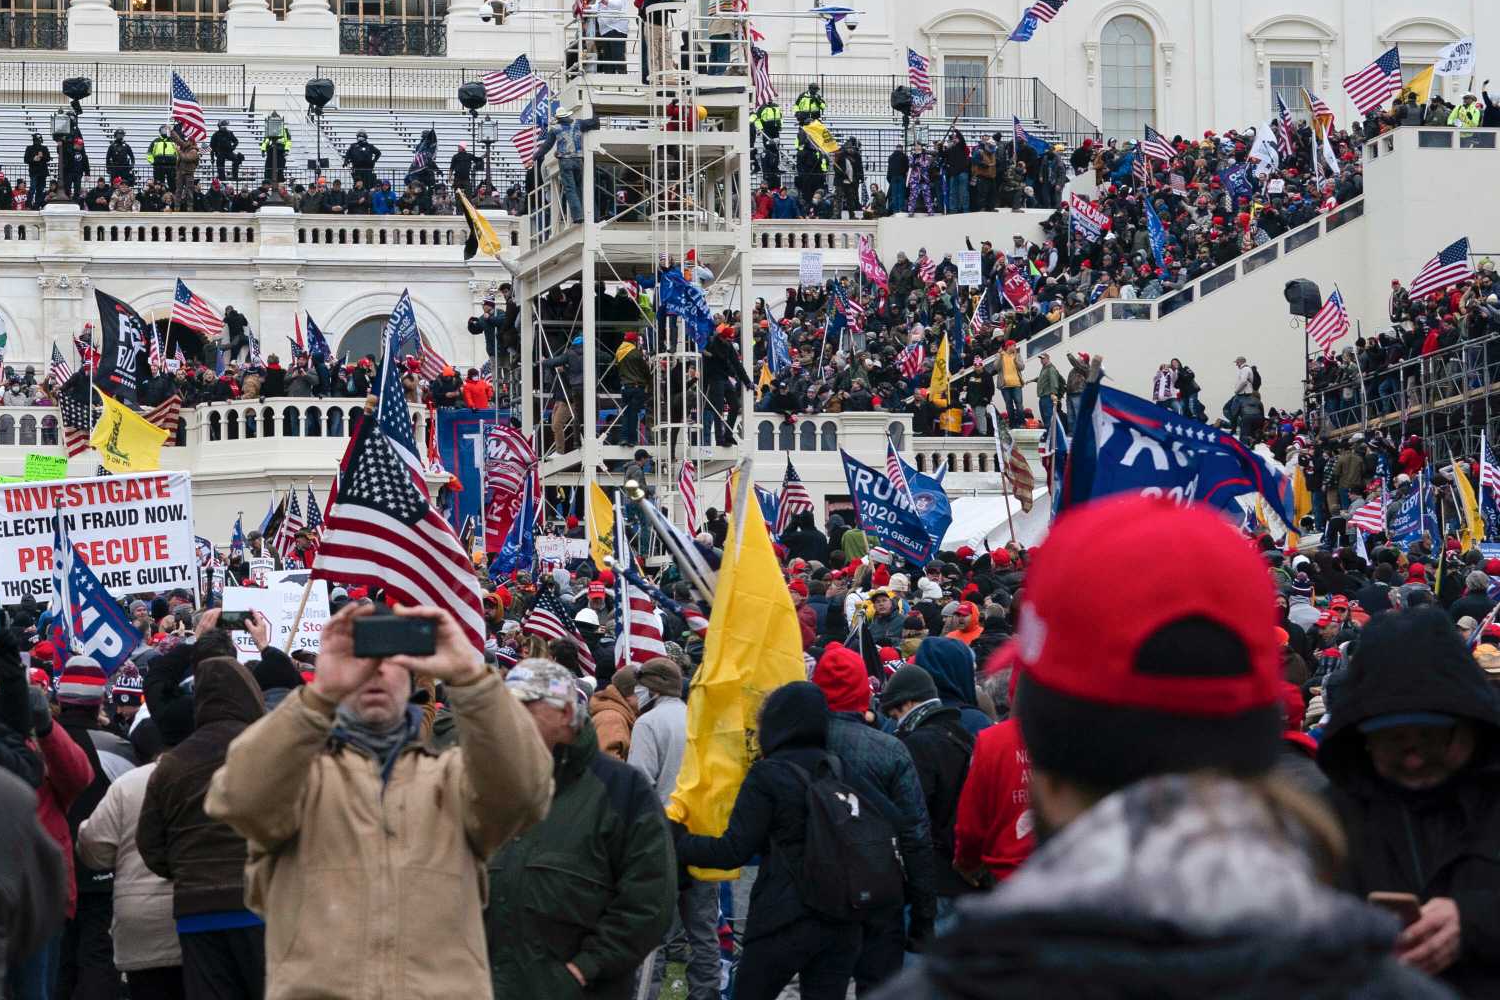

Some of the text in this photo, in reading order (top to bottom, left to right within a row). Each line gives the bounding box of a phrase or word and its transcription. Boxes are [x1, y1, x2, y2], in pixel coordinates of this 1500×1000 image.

[1072, 195, 1111, 226] TRUMP
[3, 476, 171, 512] INVESTIGATE
[81, 508, 139, 531] FRAUD
[145, 503, 187, 524] NOW.
[18, 535, 169, 573] PRSECUTE
[891, 530, 924, 552] GREAT!
[1, 564, 192, 597] THOSE ARE GUILTY.
